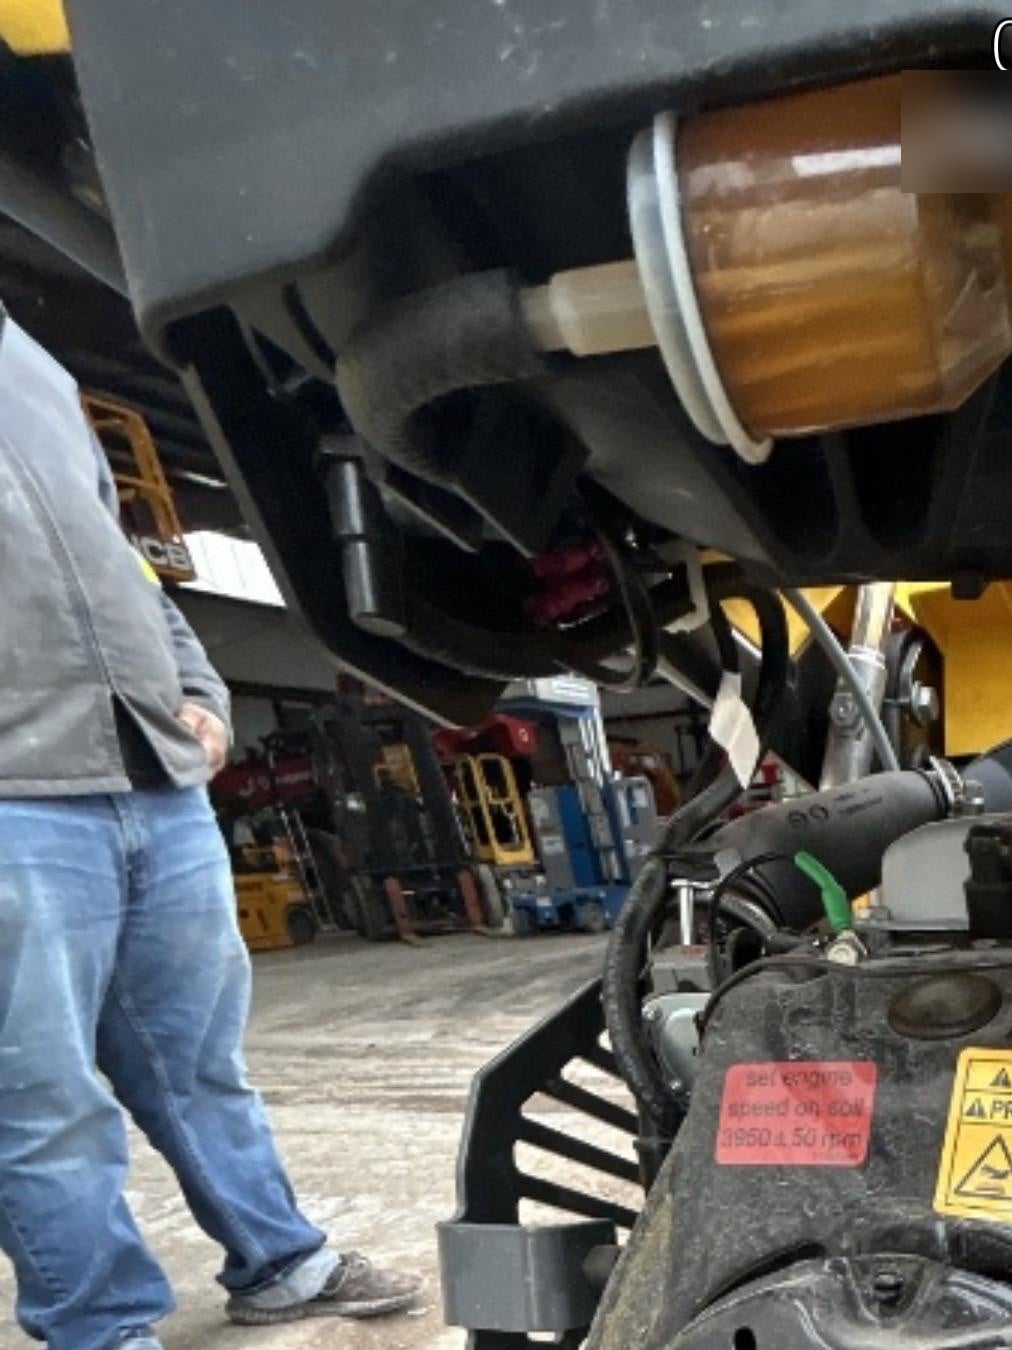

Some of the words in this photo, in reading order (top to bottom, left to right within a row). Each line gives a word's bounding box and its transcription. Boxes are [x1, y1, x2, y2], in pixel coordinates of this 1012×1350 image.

[783, 1070, 853, 1089] engine
[728, 1099, 789, 1121] speed
[795, 1103, 820, 1117] on
